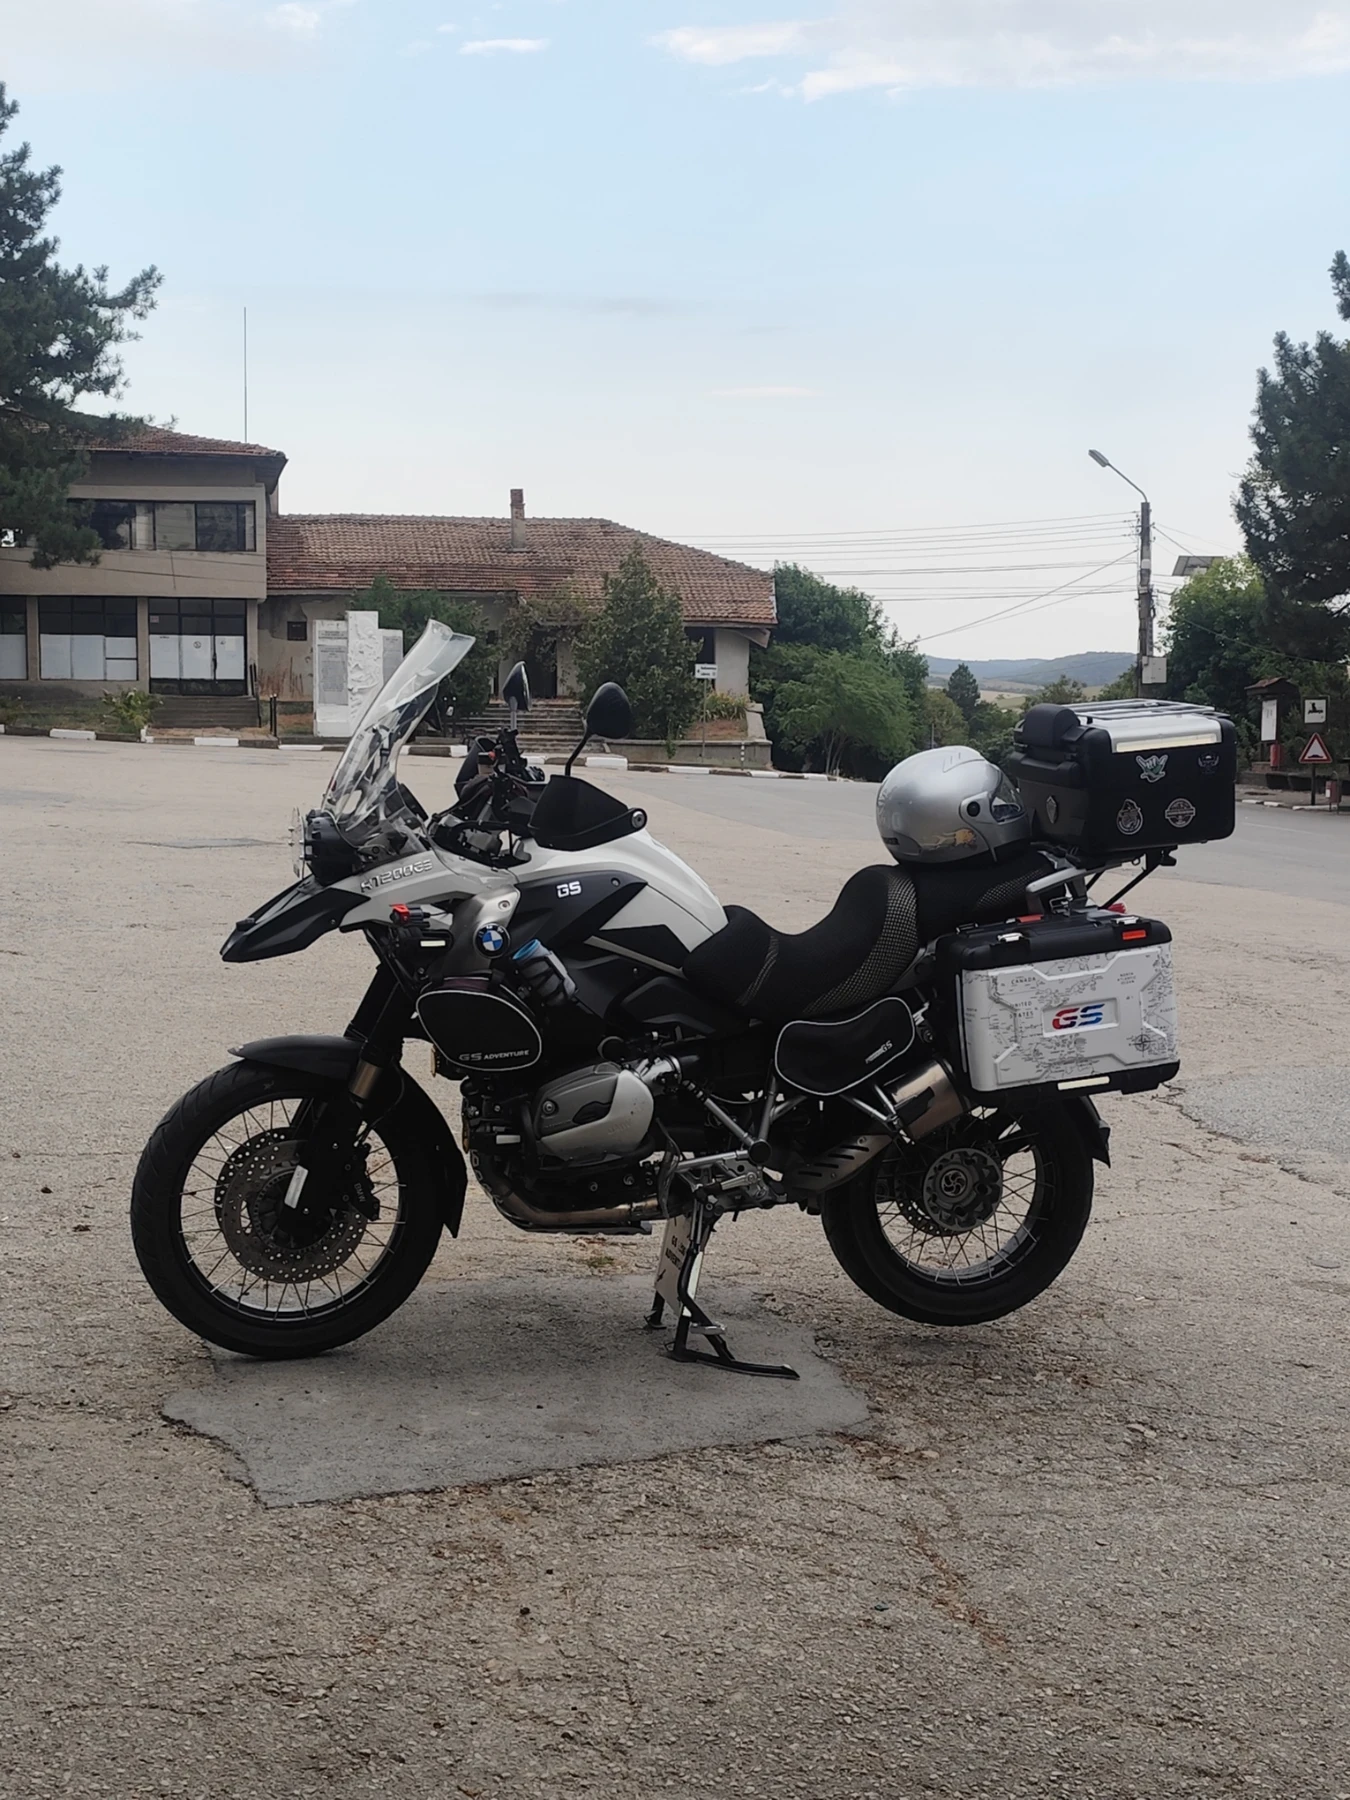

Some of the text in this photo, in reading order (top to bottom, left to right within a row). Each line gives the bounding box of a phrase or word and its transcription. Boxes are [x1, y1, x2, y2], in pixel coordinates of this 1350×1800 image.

[556, 880, 582, 899] GS
[1051, 1003, 1105, 1030] GS
[459, 1049, 530, 1061] GS ADVENTURE
